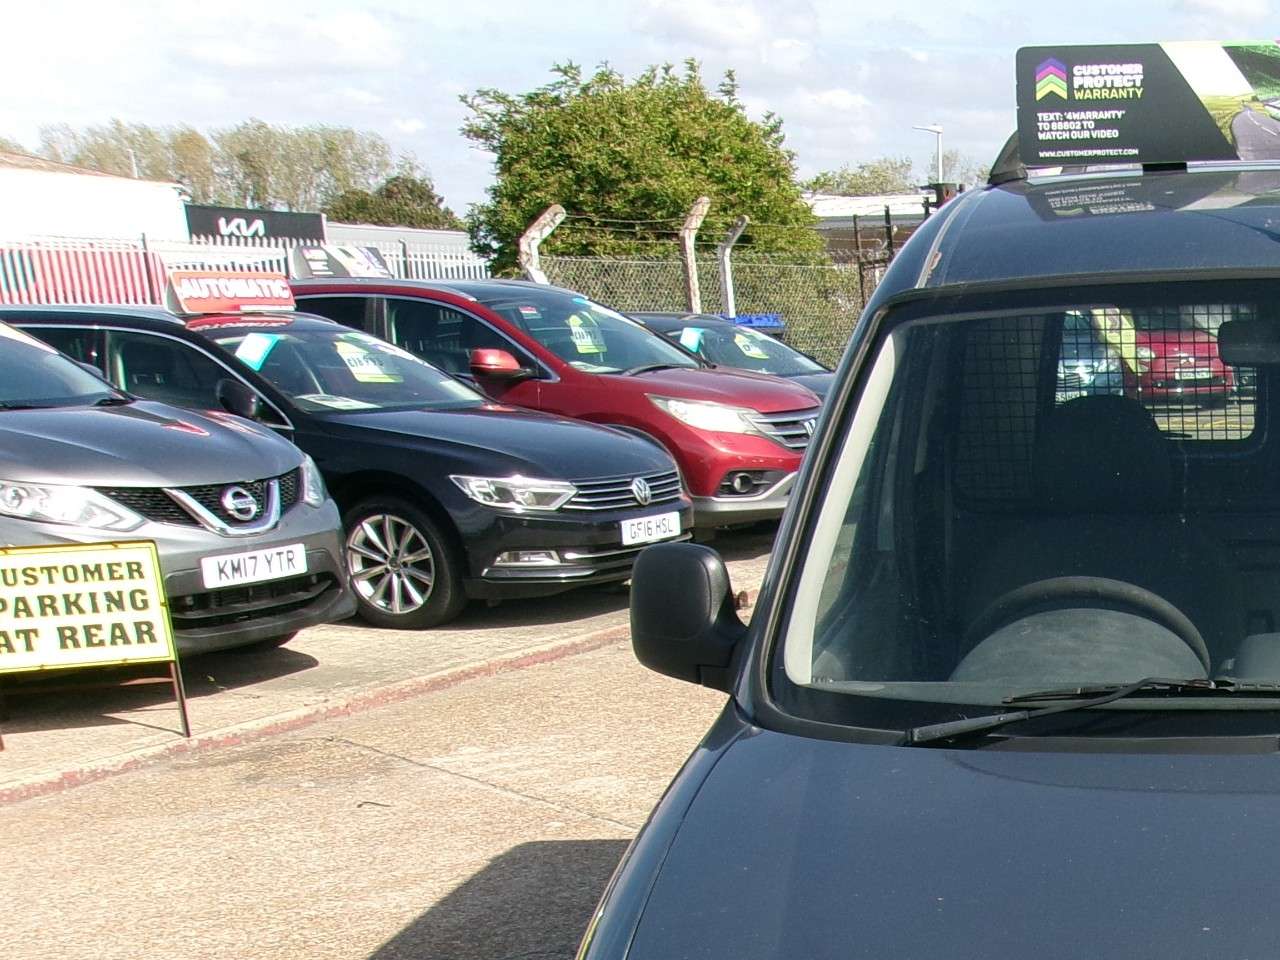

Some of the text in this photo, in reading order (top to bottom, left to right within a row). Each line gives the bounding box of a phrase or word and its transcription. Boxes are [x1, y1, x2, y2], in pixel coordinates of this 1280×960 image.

[1073, 63, 1143, 76] CUSTOMER
[1073, 75, 1143, 89] PROTECT
[1074, 87, 1143, 100] WARRANTY
[1037, 111, 1063, 122] TEXT:
[1037, 121, 1050, 131] TO
[1082, 120, 1095, 130] TO
[1038, 129, 1119, 140] WATCH OUR VIDEO
[179, 277, 290, 299] AUTOMATIC
[655, 517, 674, 534] HSL
[217, 550, 296, 581] KM17 YTR
[1, 561, 145, 587] USTOMER
[56, 620, 158, 650] REAR
